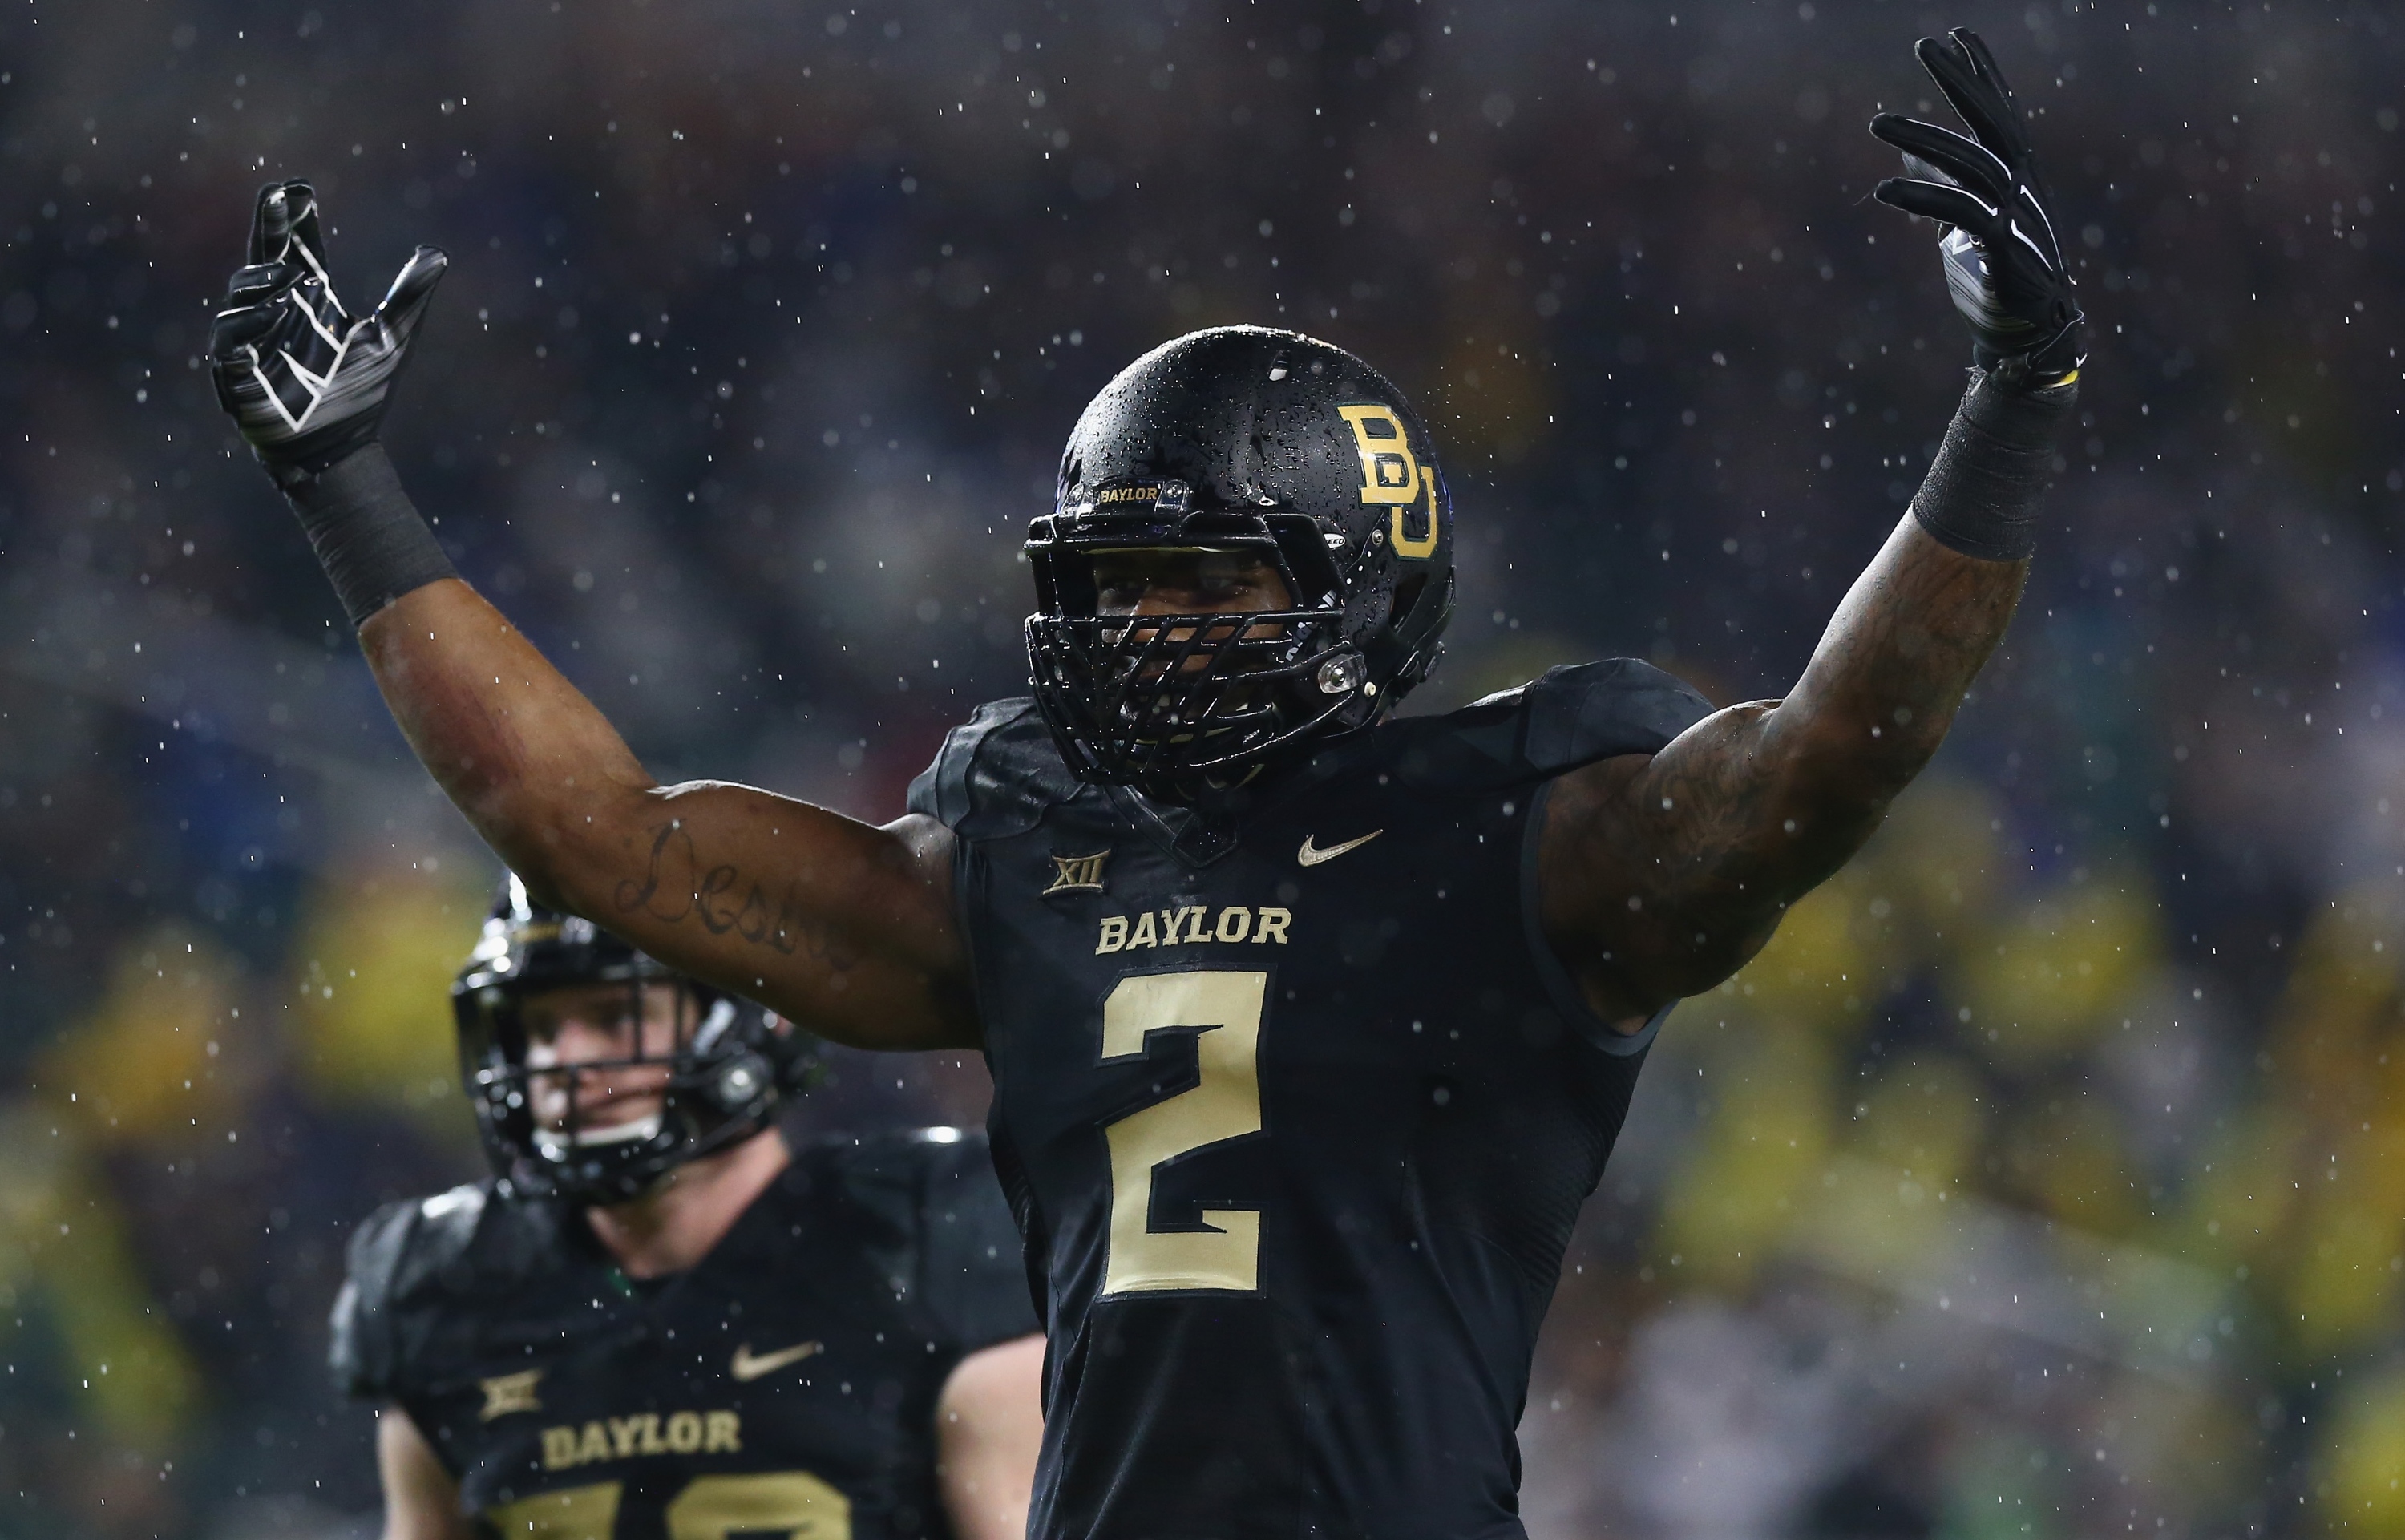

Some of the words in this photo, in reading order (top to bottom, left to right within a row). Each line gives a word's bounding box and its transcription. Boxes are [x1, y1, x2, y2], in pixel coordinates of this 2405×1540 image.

[1100, 487, 1158, 503] BAYLOR
[1337, 404, 1437, 559] BU
[1095, 906, 1291, 956] BAYLOR
[1101, 971, 1267, 1296] 2
[540, 1409, 742, 1472] BAYLOR
